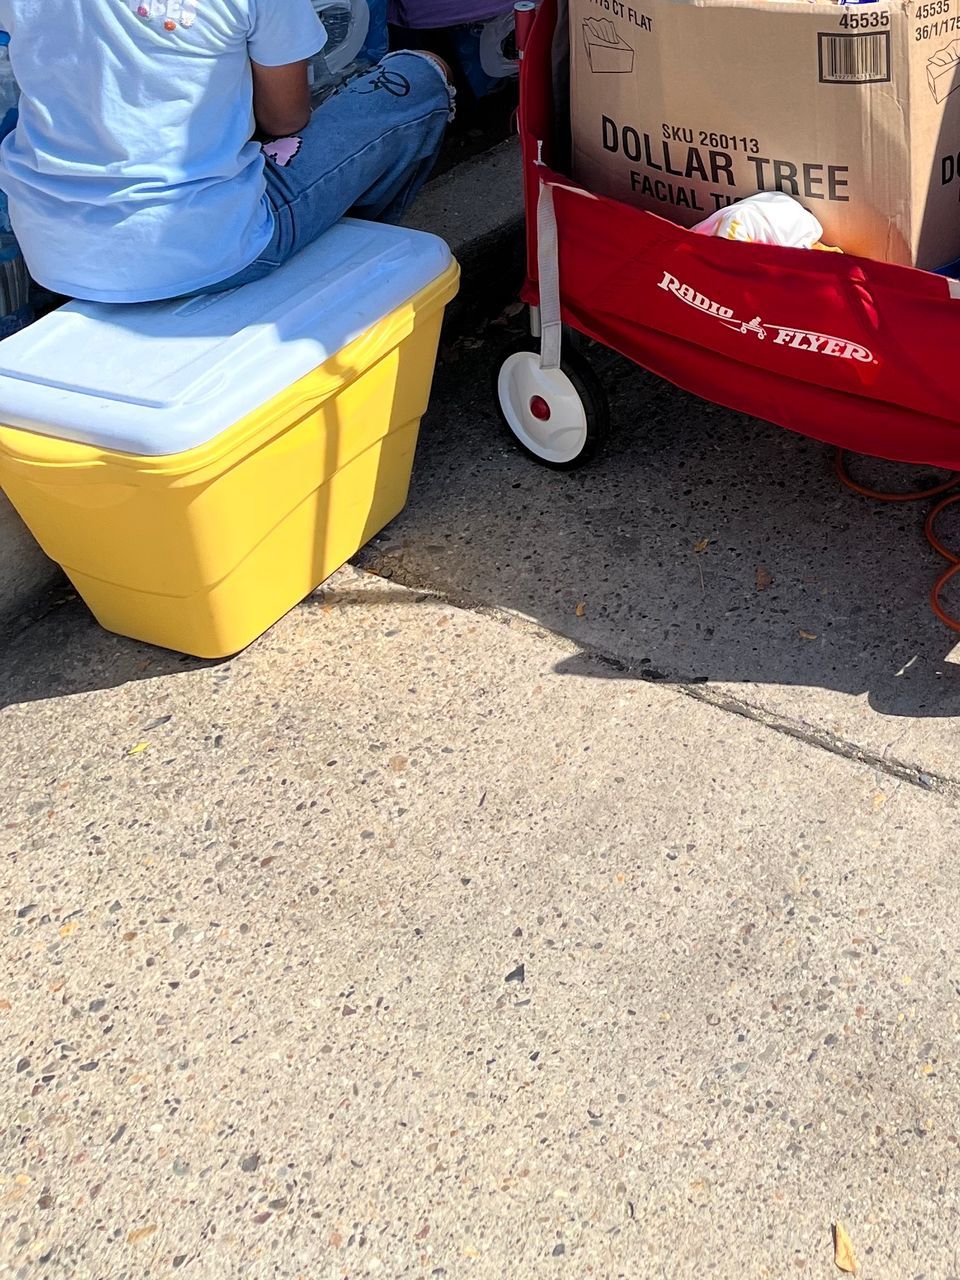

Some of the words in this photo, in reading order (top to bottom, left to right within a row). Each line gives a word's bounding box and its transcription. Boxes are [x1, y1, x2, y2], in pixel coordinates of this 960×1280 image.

[612, 0, 625, 19] CT
[628, 6, 653, 33] FLAT
[839, 11, 890, 30] 45535
[662, 123, 694, 144] SKU
[699, 130, 760, 154] 260113
[601, 114, 737, 187] DOLLAR
[747, 155, 851, 203] TREE
[630, 170, 705, 212] FACIAL
[657, 271, 736, 320] RADIO
[773, 328, 874, 364] FLYER
